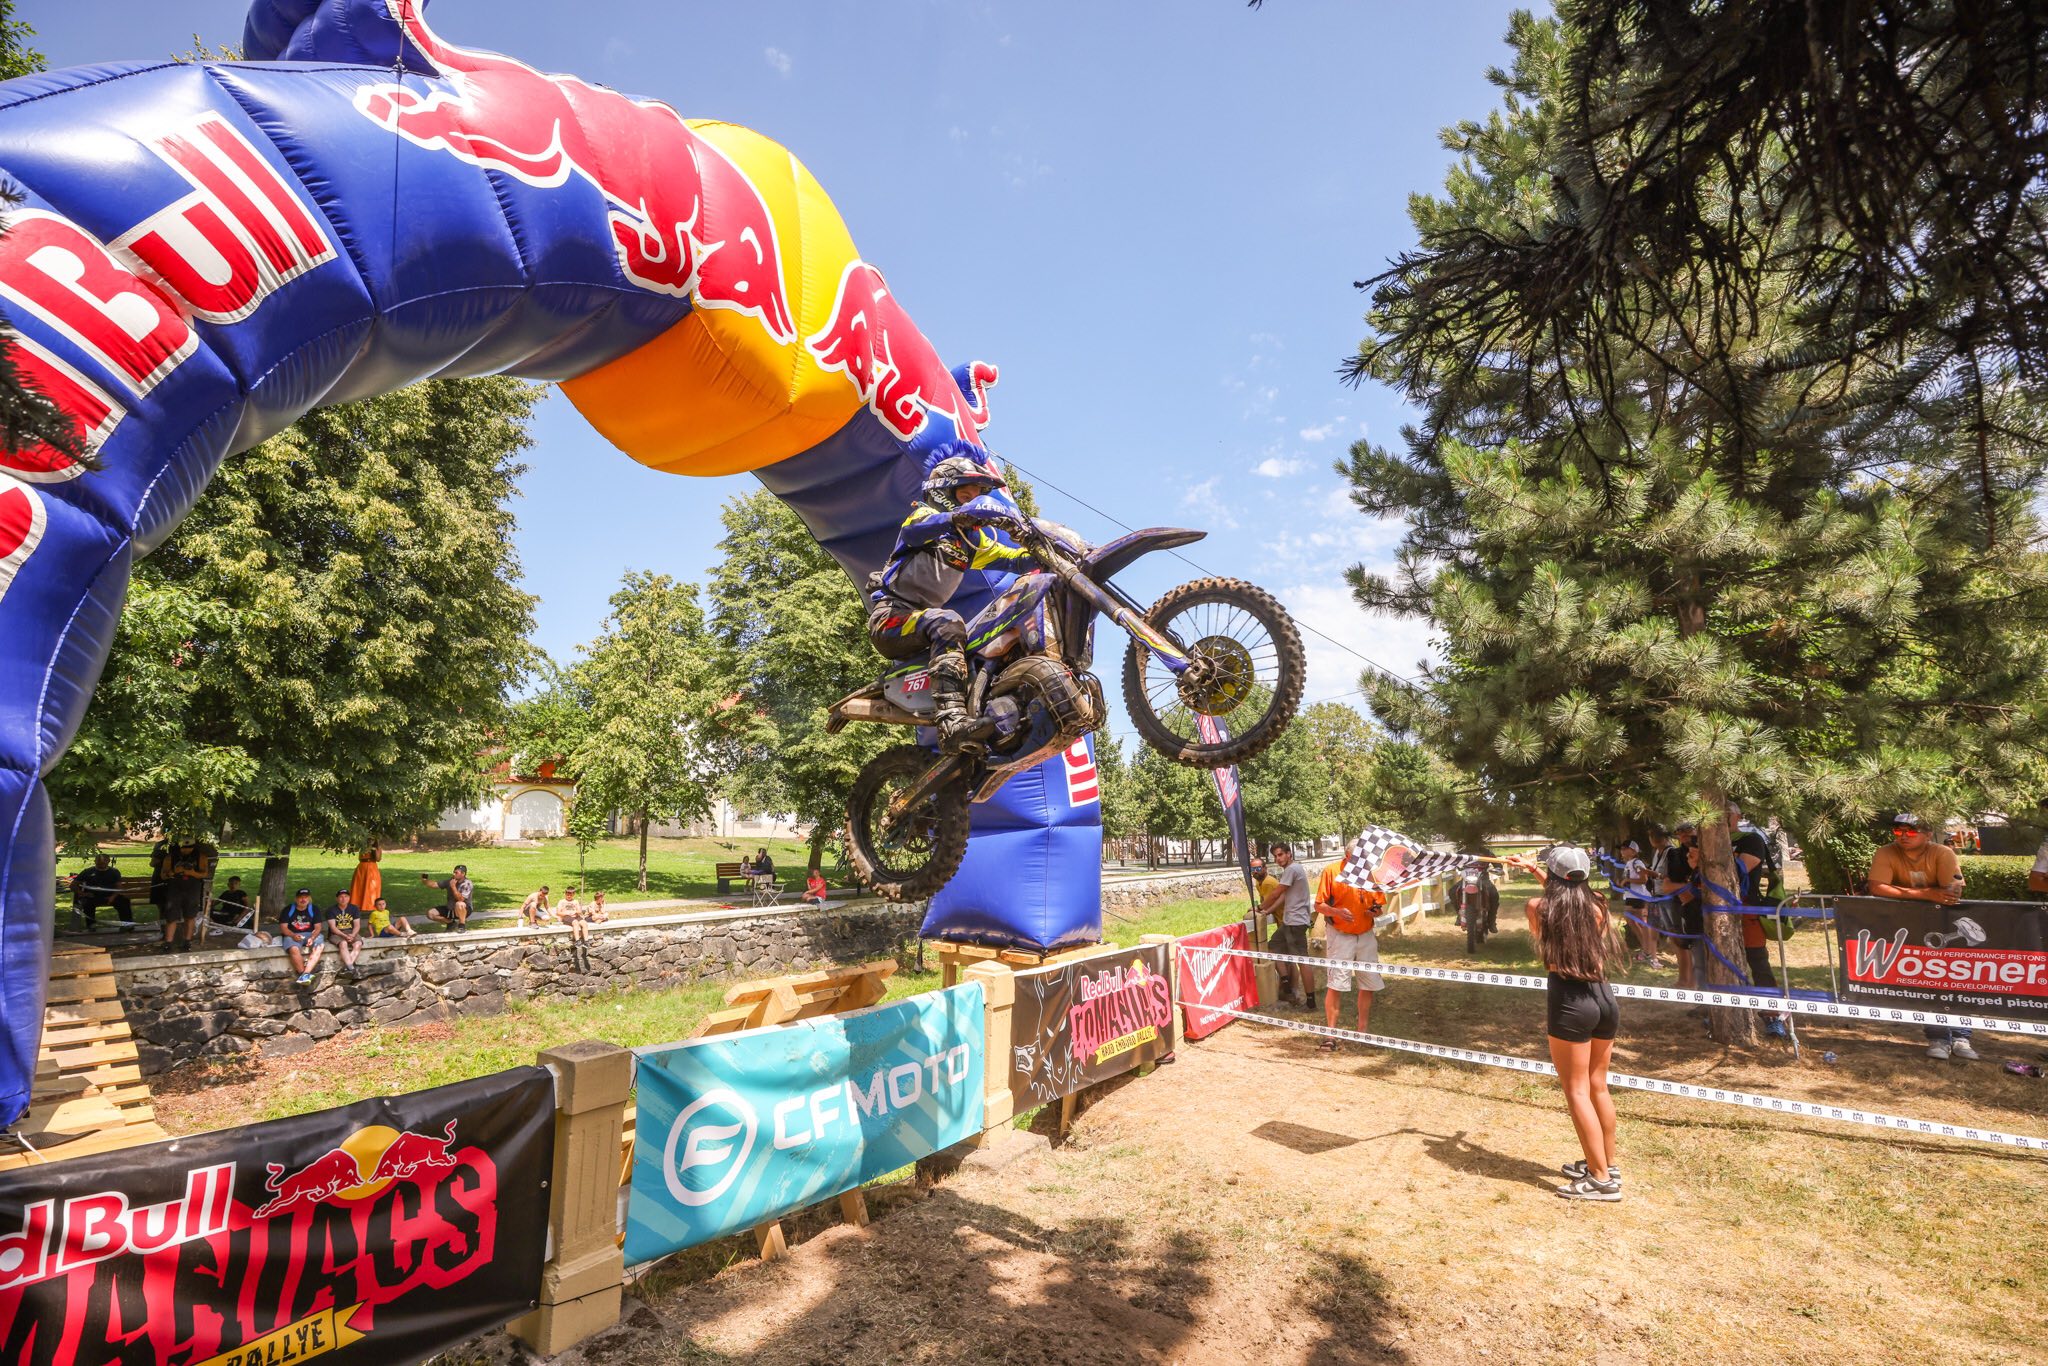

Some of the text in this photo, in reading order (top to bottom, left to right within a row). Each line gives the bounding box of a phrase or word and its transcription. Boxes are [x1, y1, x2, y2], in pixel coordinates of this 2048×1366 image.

[0, 110, 337, 399] Bull
[908, 678, 926, 691] 767
[1061, 736, 1100, 808] ull
[1944, 951, 2006, 960] PERFORMANCE
[2008, 954, 2047, 962] PISTONS
[1081, 966, 1123, 1002] Red Bull
[1848, 983, 1937, 1000] Manufacturer
[1940, 993, 1954, 1002] of
[1957, 994, 2003, 1006] forged
[1896, 978, 2014, 992] RESEARCH & DEVELOPMENT
[1101, 1042, 1115, 1057] HARD
[1115, 1034, 1137, 1051] ENDURO
[773, 1041, 970, 1151] CFMOTO
[55, 1160, 237, 1273] Bull
